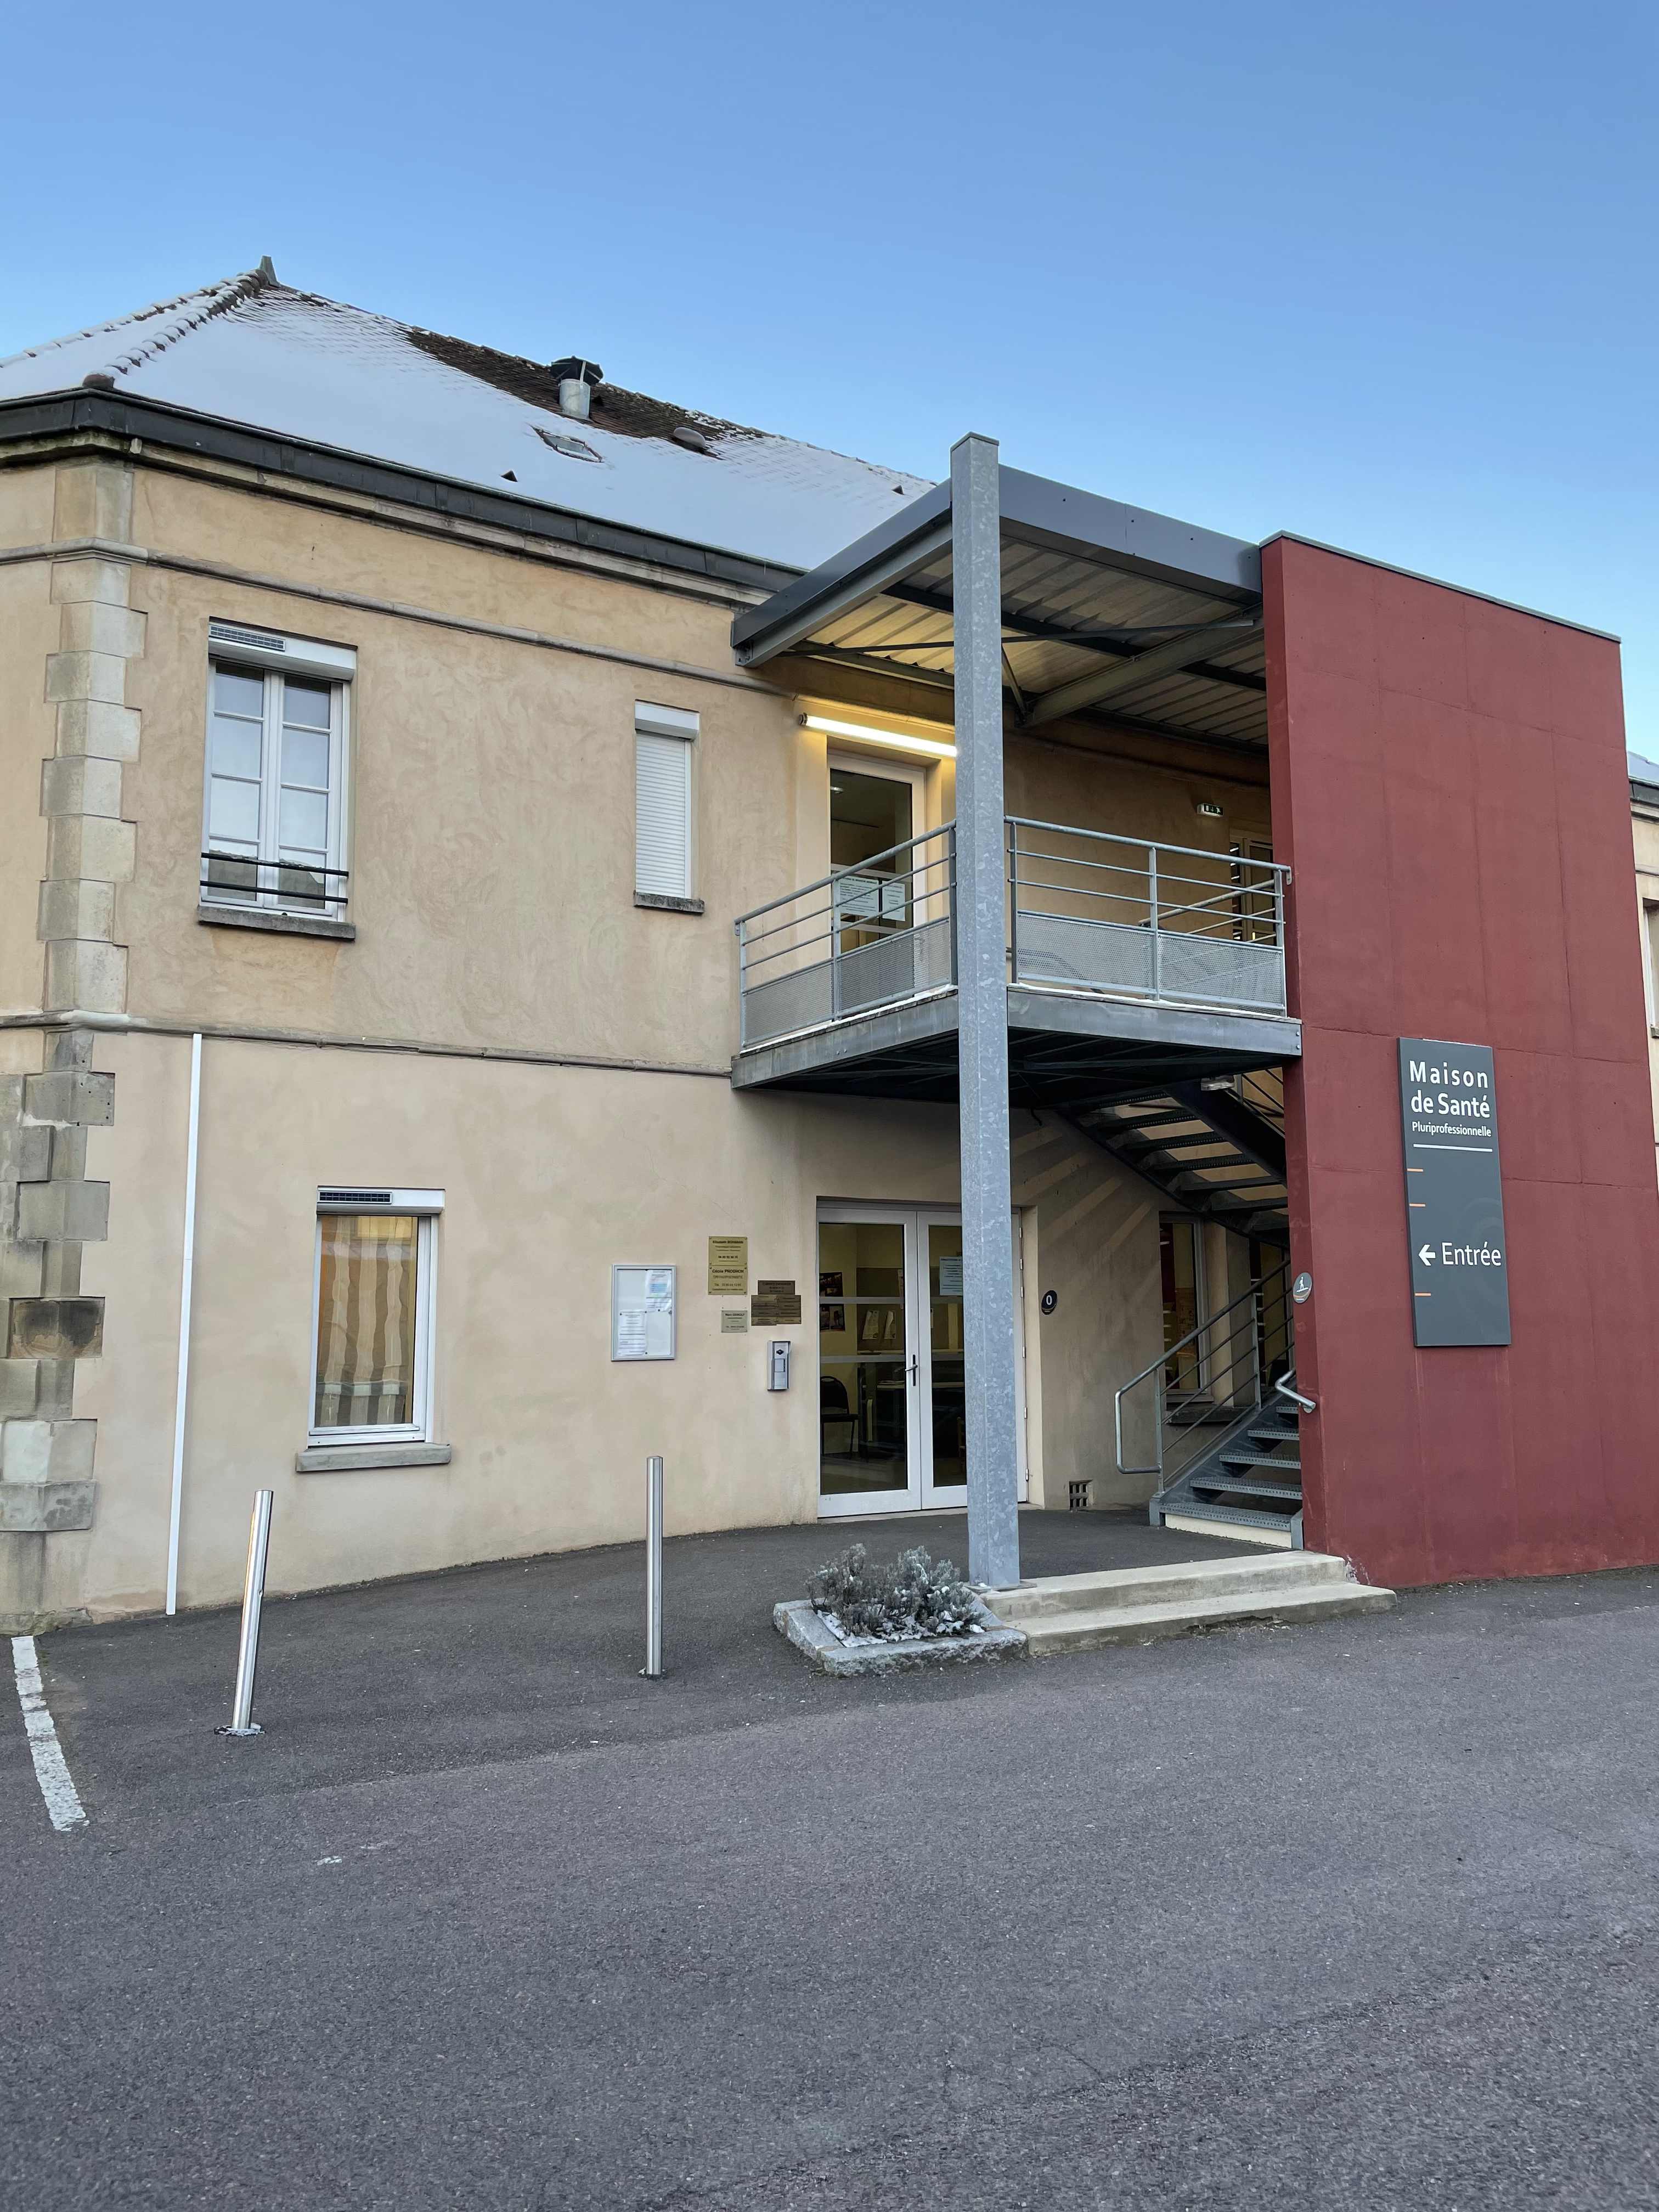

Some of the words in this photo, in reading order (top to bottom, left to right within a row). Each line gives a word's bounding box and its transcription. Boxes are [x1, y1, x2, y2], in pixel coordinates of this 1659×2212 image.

[1409, 1060, 1488, 1088] Maison
[1410, 1089, 1434, 1114] de
[1437, 1092, 1491, 1119] Santé
[1412, 1121, 1492, 1137] Pluriprofessionnelle
[1442, 1241, 1502, 1267] Entrée
